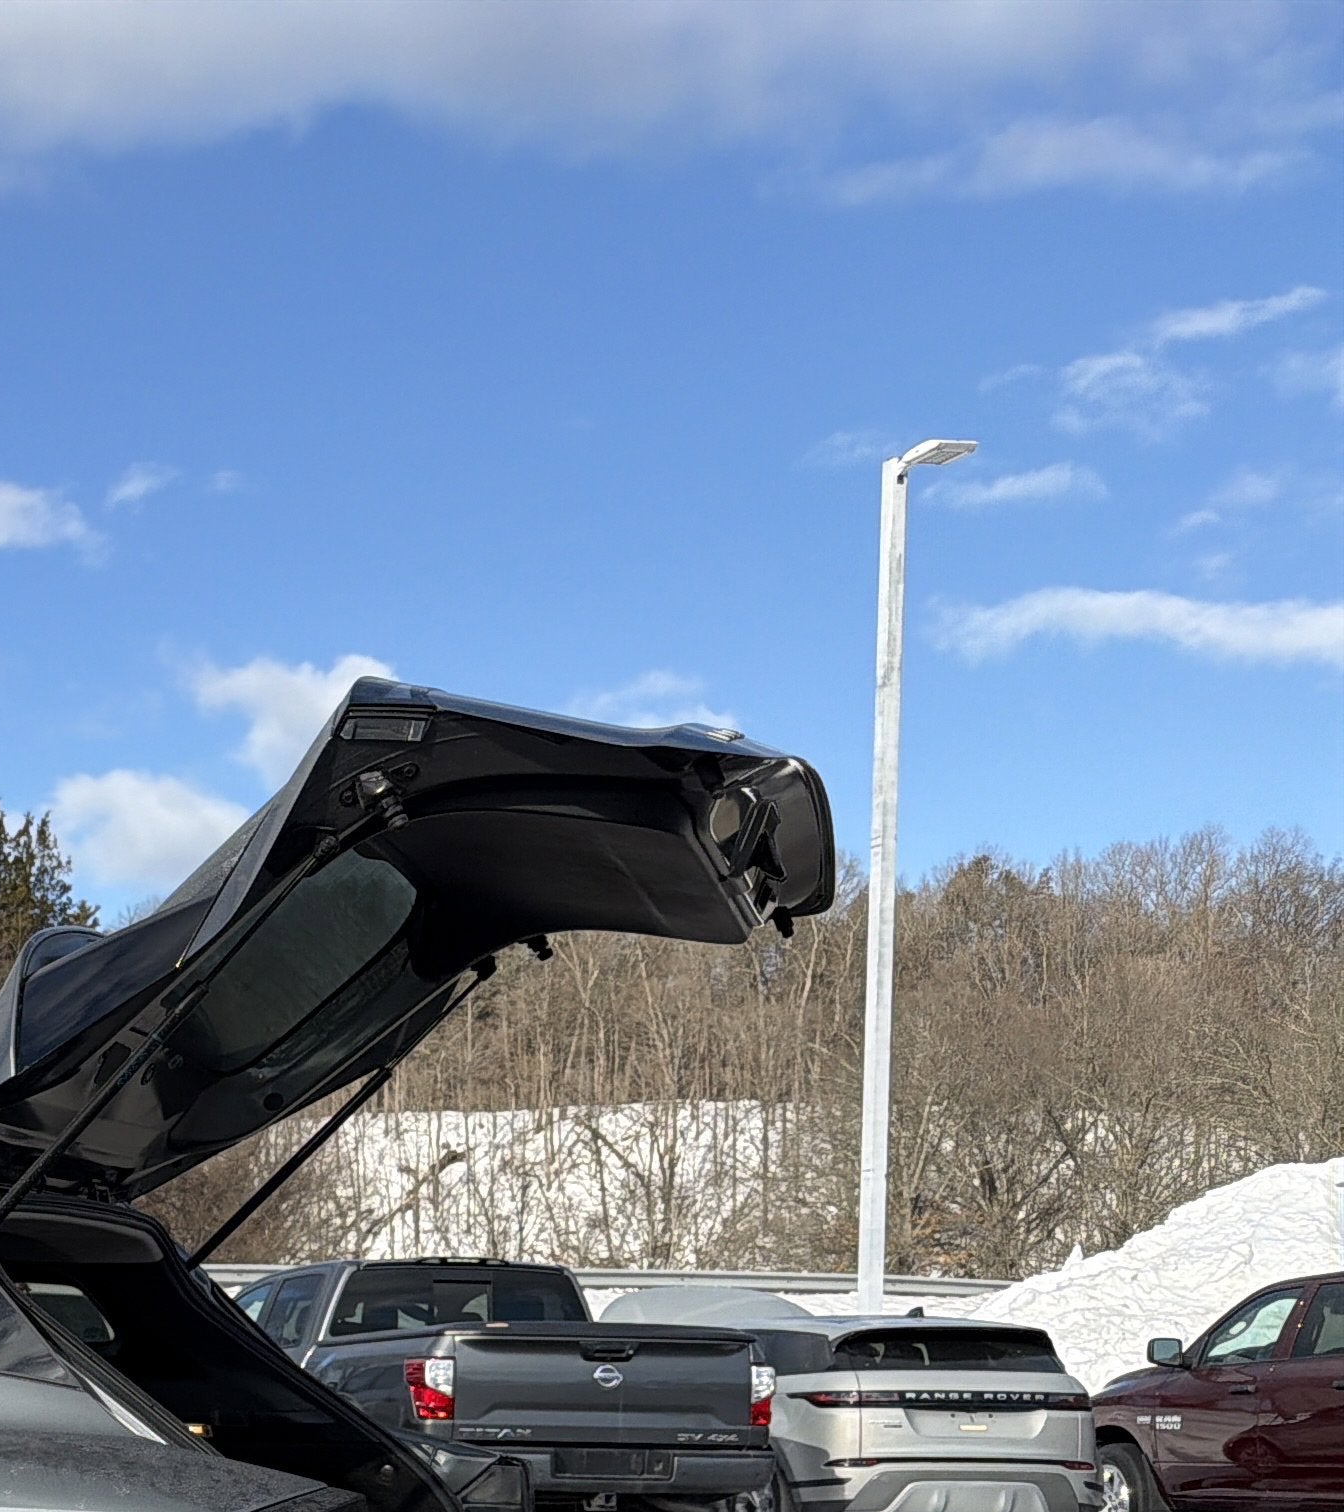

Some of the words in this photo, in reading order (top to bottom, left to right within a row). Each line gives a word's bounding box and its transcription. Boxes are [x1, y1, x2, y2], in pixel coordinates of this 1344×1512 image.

[905, 1392, 973, 1401] RANGE
[983, 1392, 1045, 1401] ROVER
[1155, 1422, 1181, 1430] 1500
[458, 1427, 532, 1440] TITAN
[677, 1432, 704, 1442] SV
